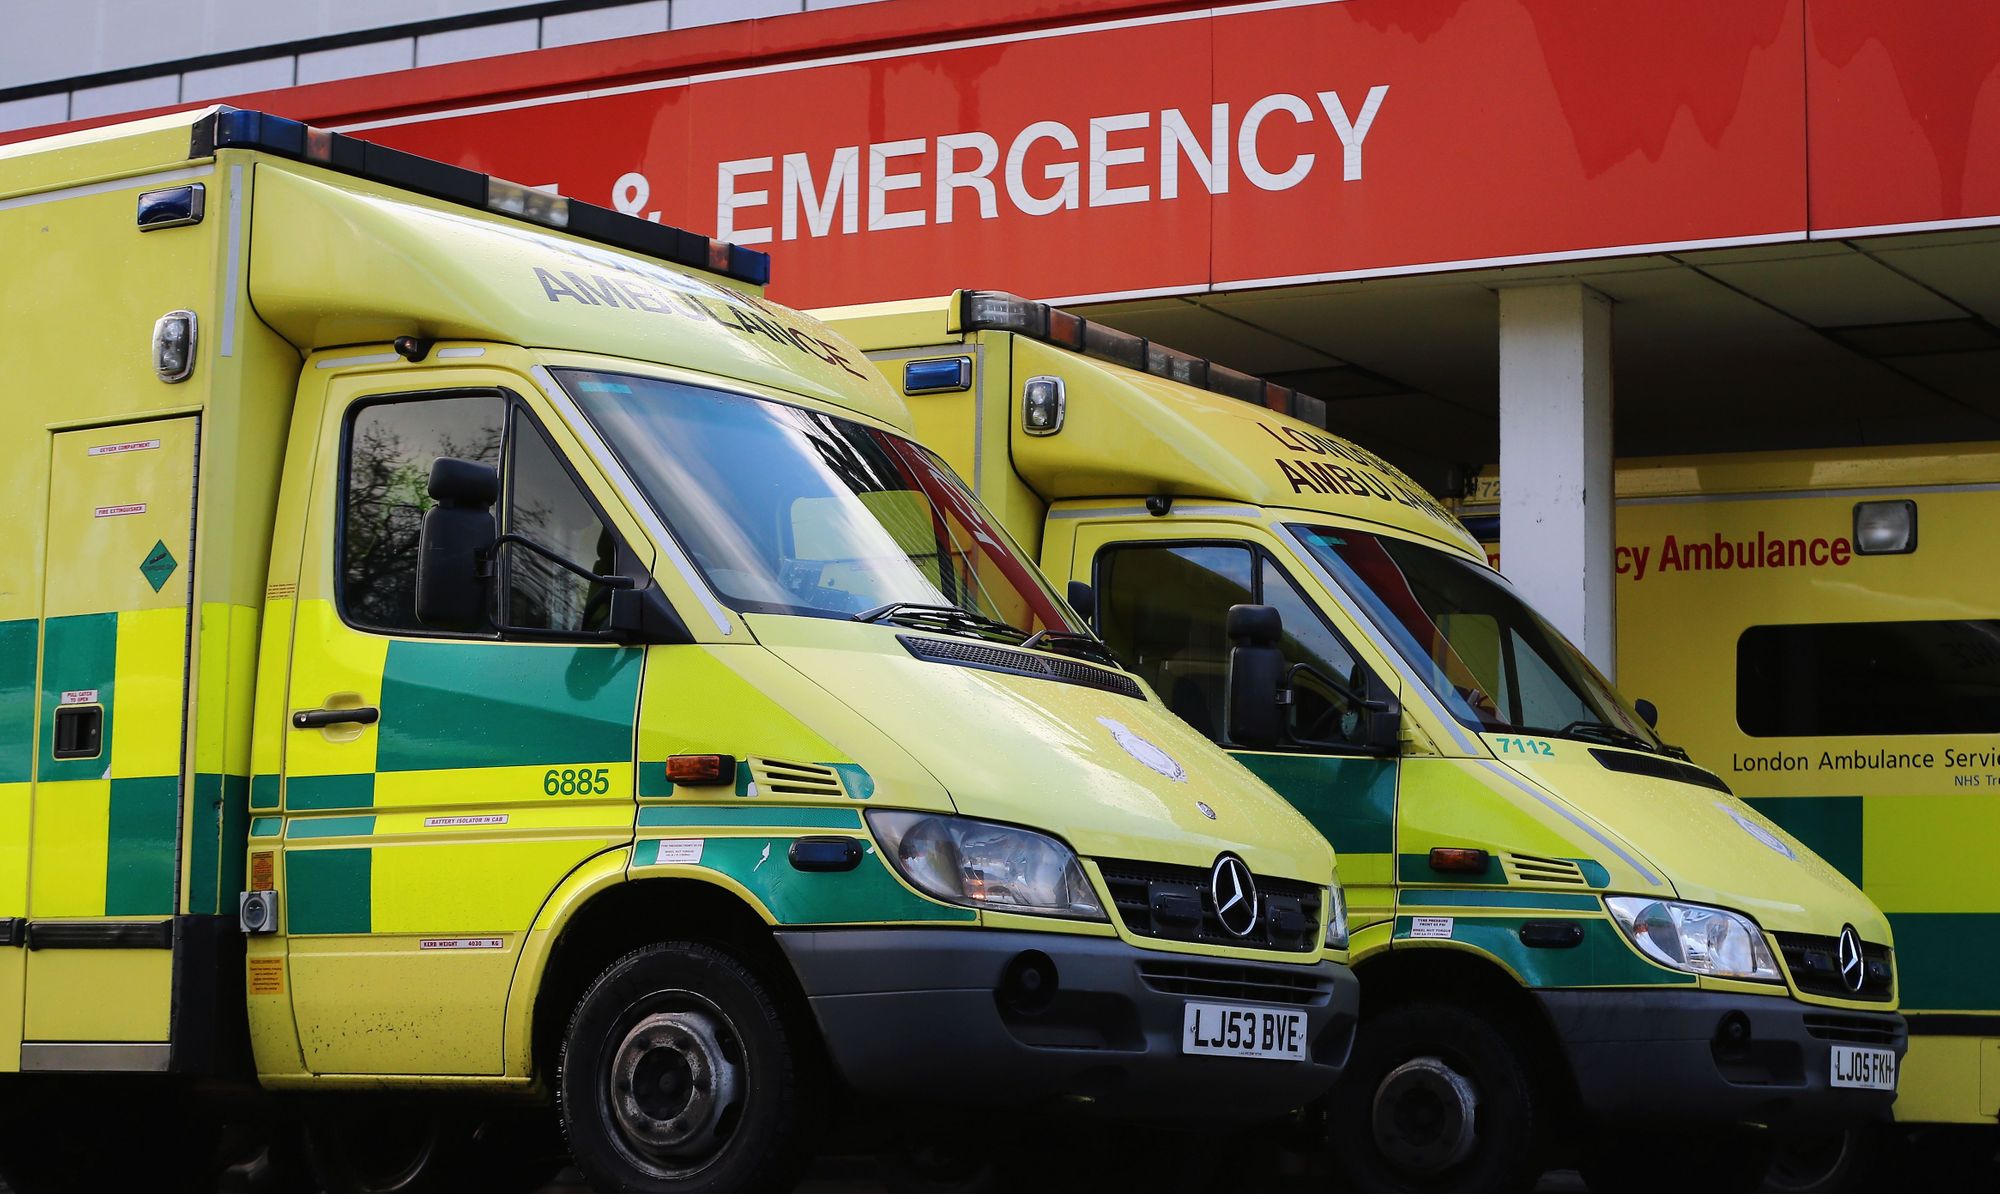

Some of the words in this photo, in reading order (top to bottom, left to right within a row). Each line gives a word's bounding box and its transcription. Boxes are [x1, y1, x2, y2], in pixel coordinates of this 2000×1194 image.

[612, 172, 662, 224] &
[716, 85, 1390, 246] EMERGENCY
[532, 266, 869, 382] AMBULANCE
[1658, 531, 1851, 572] Ambulance
[1496, 738, 1555, 756] 7112
[1733, 751, 1809, 772] London
[1818, 749, 1934, 771] Ambulance
[1944, 746, 2000, 768] Servi
[543, 768, 610, 796] 6885
[1954, 775, 1980, 787] NHS
[1985, 774, 2000, 786] Tr
[1194, 1009, 1257, 1049] LJ53
[1261, 1013, 1300, 1052] BVE
[1836, 1050, 1870, 1082] LJ05
[1872, 1053, 1893, 1084] FKH
